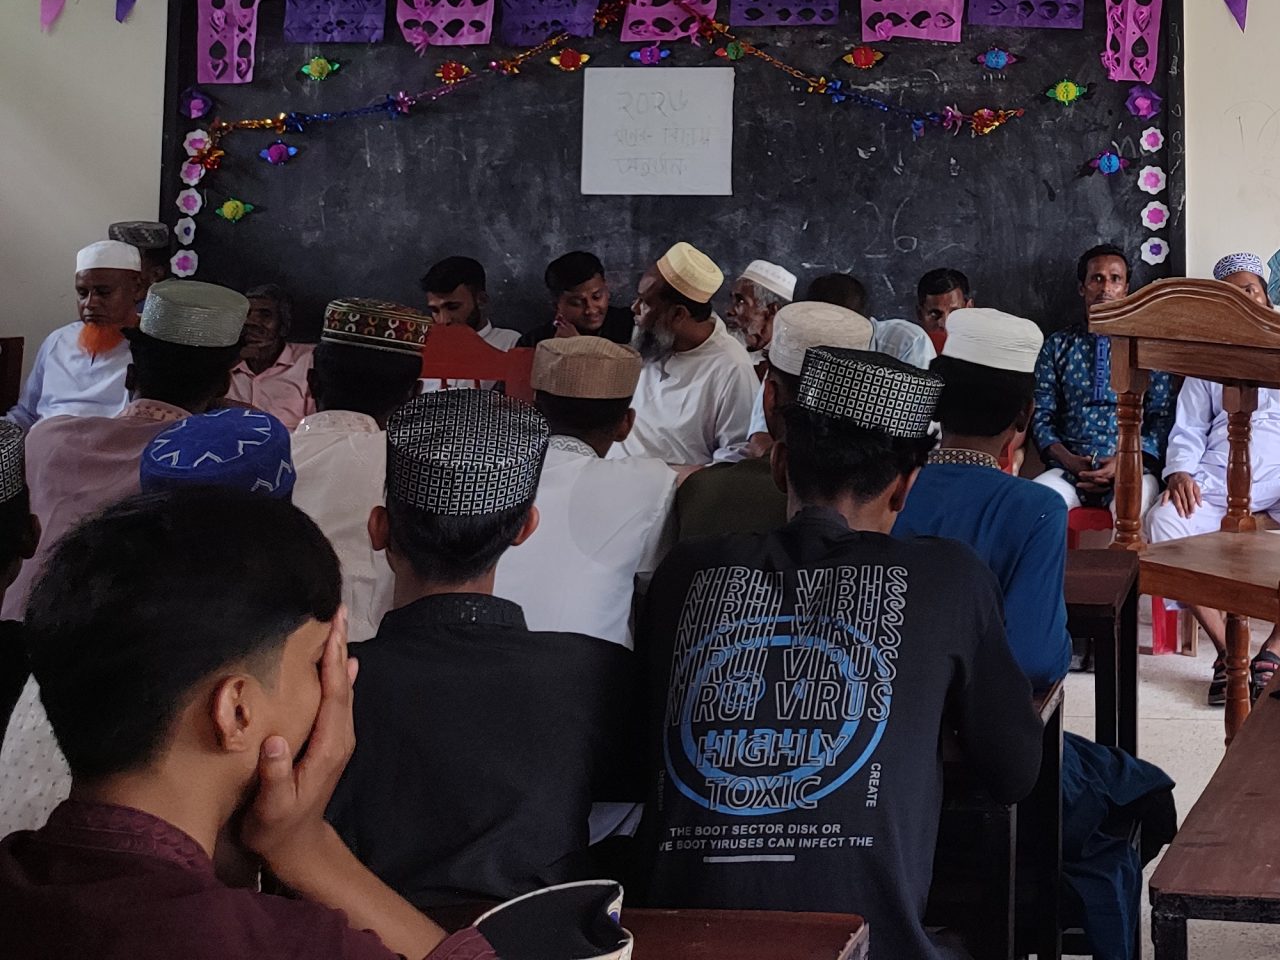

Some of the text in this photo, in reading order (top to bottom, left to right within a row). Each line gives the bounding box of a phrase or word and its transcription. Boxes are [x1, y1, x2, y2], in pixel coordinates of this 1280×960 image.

[696, 733, 852, 768] HIGHLY
[705, 776, 821, 810] TOXIC
[866, 762, 882, 808] CREATE
[670, 823, 841, 837] THE BOOT SECTOR DISK OR
[676, 840, 706, 850] BOOT
[767, 838, 795, 848] CAN
[798, 837, 845, 848] INFECT
[848, 836, 874, 847] THE
